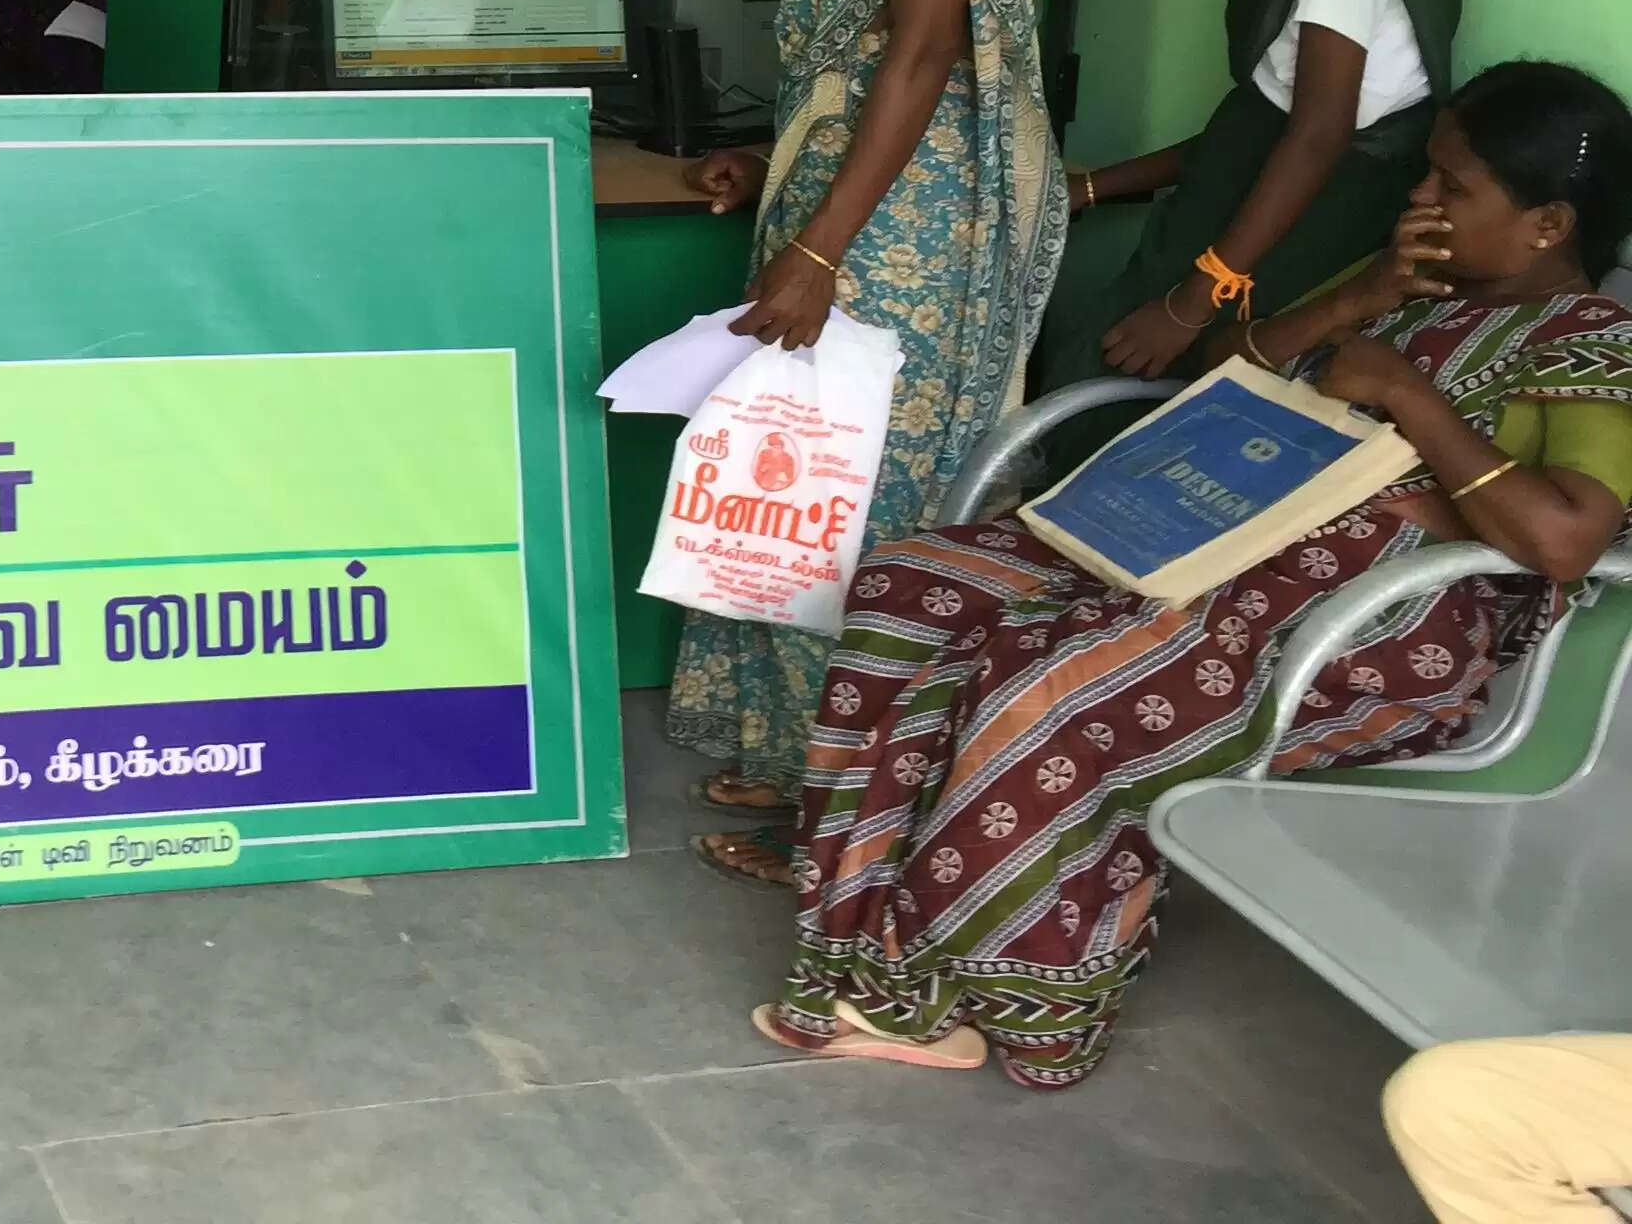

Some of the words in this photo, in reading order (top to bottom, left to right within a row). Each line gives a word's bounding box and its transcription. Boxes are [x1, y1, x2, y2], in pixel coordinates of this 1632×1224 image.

[105, 560, 387, 661] மையம்
[45, 736, 265, 791] கீழக்கரை
[40, 838, 94, 871] டிவி
[105, 826, 235, 869] நிறுவனம்
